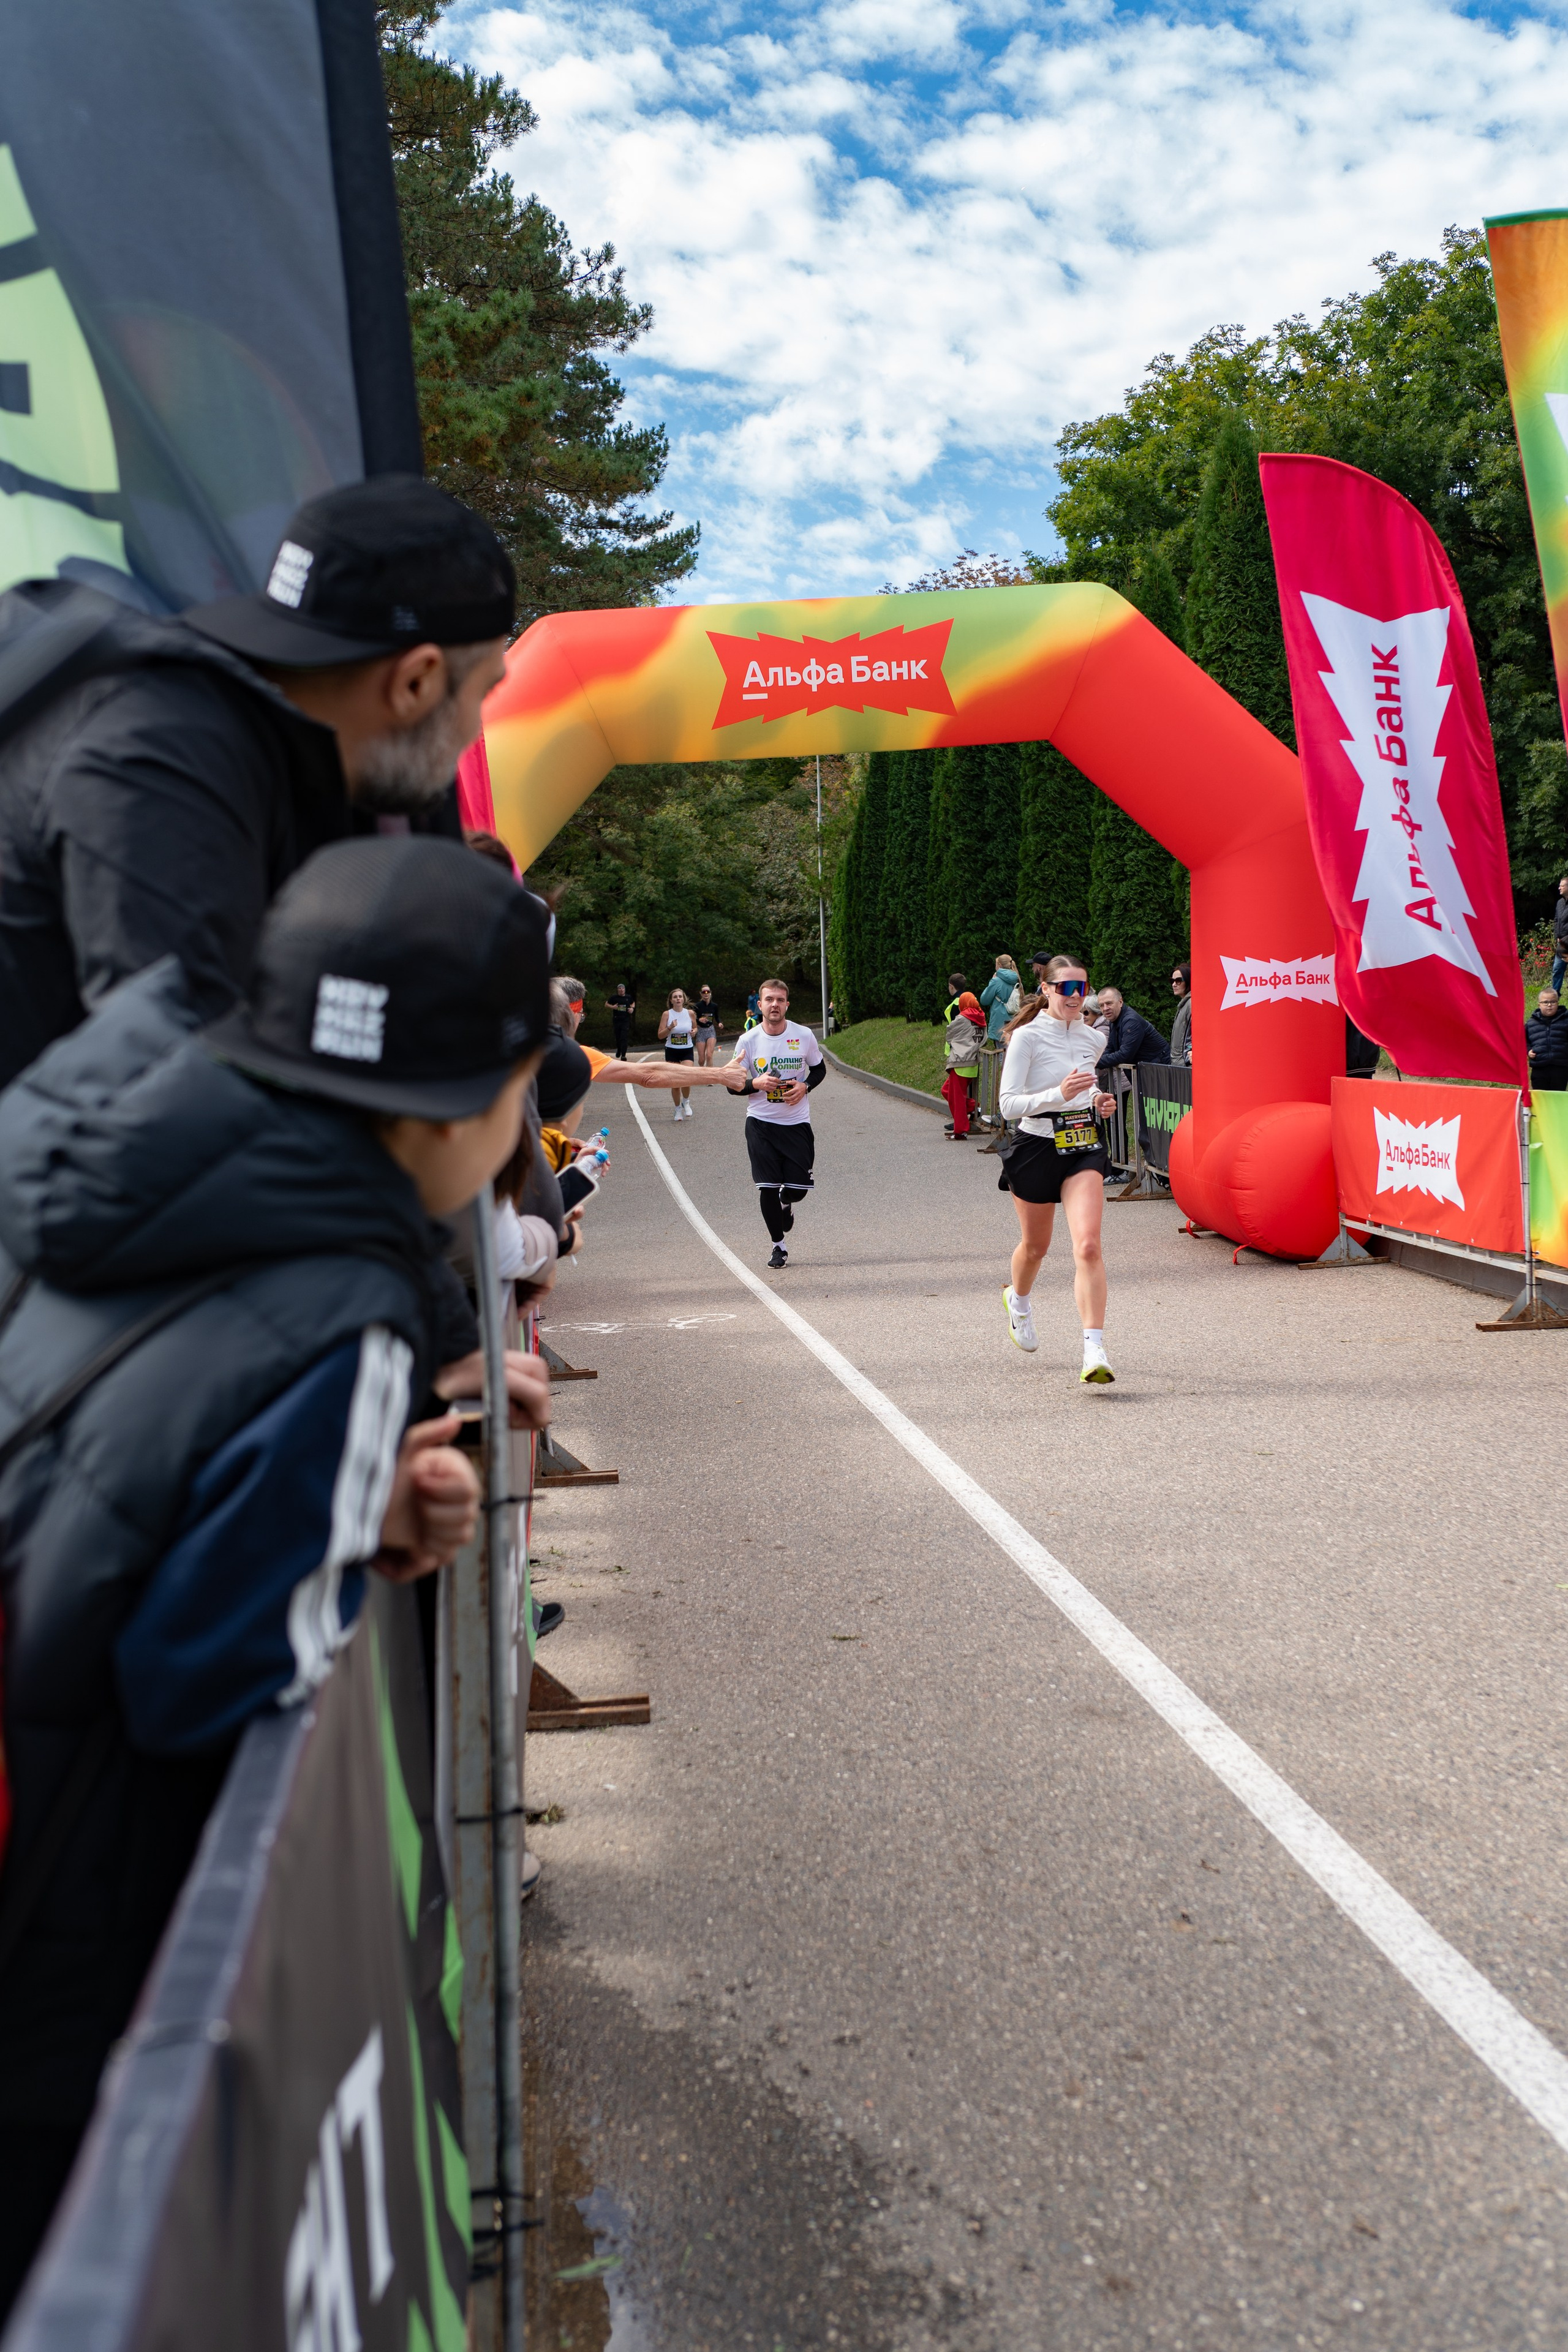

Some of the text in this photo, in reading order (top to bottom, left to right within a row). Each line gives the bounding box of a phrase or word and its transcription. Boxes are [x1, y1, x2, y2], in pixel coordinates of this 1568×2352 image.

[743, 655, 929, 692] Альфа Банк
[1371, 643, 1408, 767] Банк
[1236, 971, 1330, 989] Альфа Банк
[771, 1057, 803, 1065] Долина
[1143, 1096, 1193, 1134] KAVKAZ
[1065, 1129, 1091, 1144] 5177
